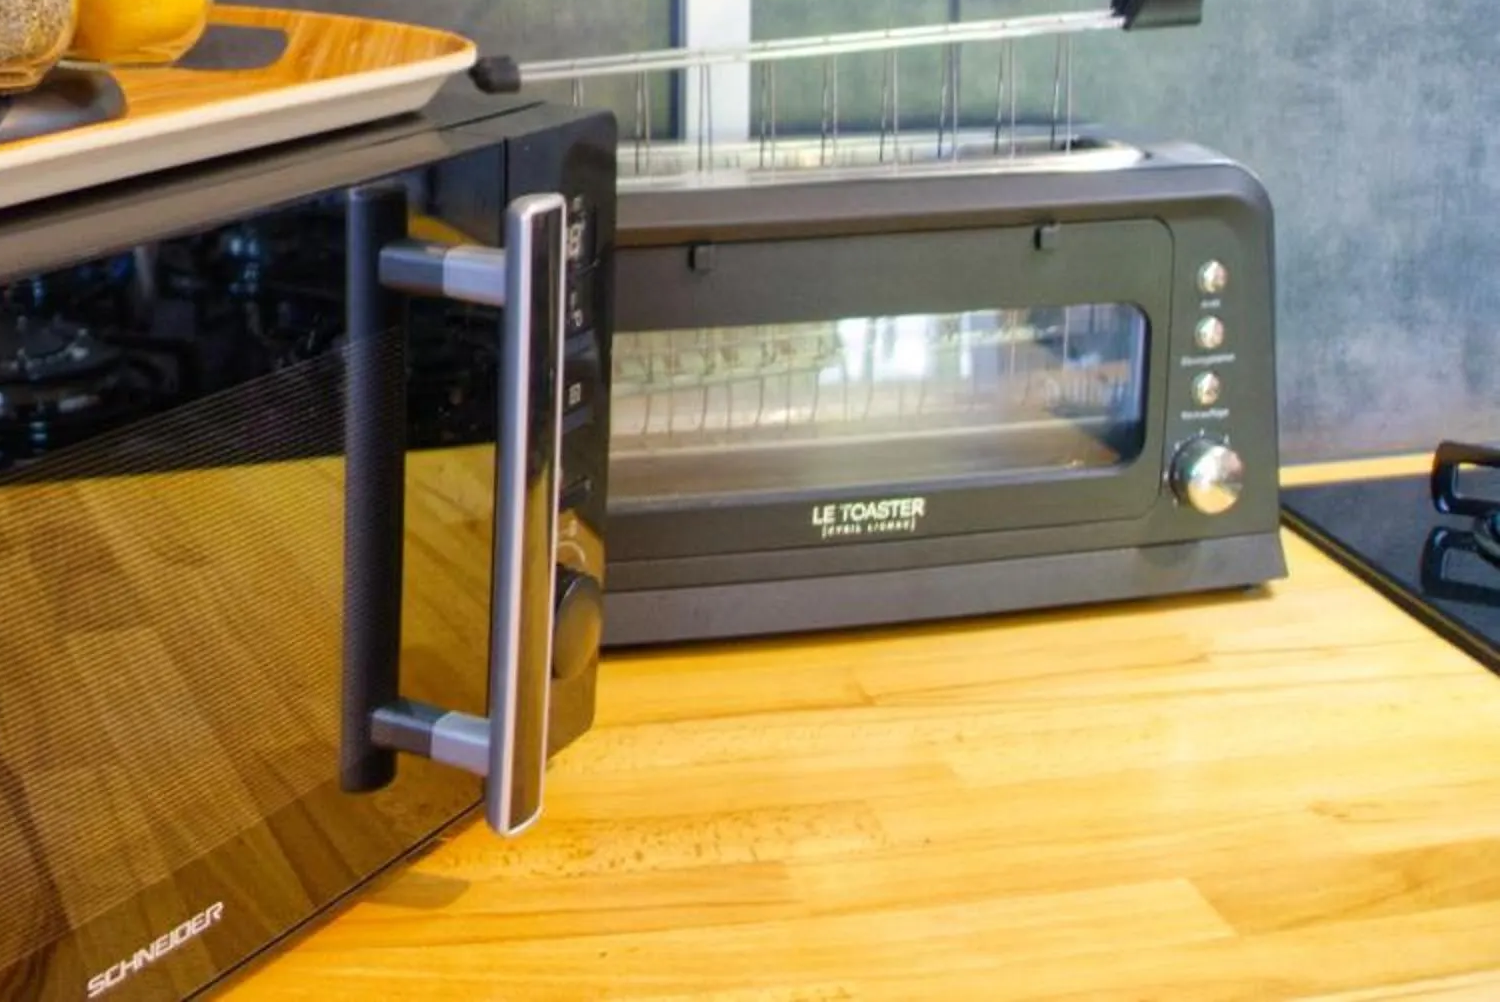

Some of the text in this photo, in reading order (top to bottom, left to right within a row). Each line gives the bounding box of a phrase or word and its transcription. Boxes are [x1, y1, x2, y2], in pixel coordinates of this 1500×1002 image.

[812, 497, 925, 525] LE TOASTER
[87, 901, 224, 998] SCHNEIDER
